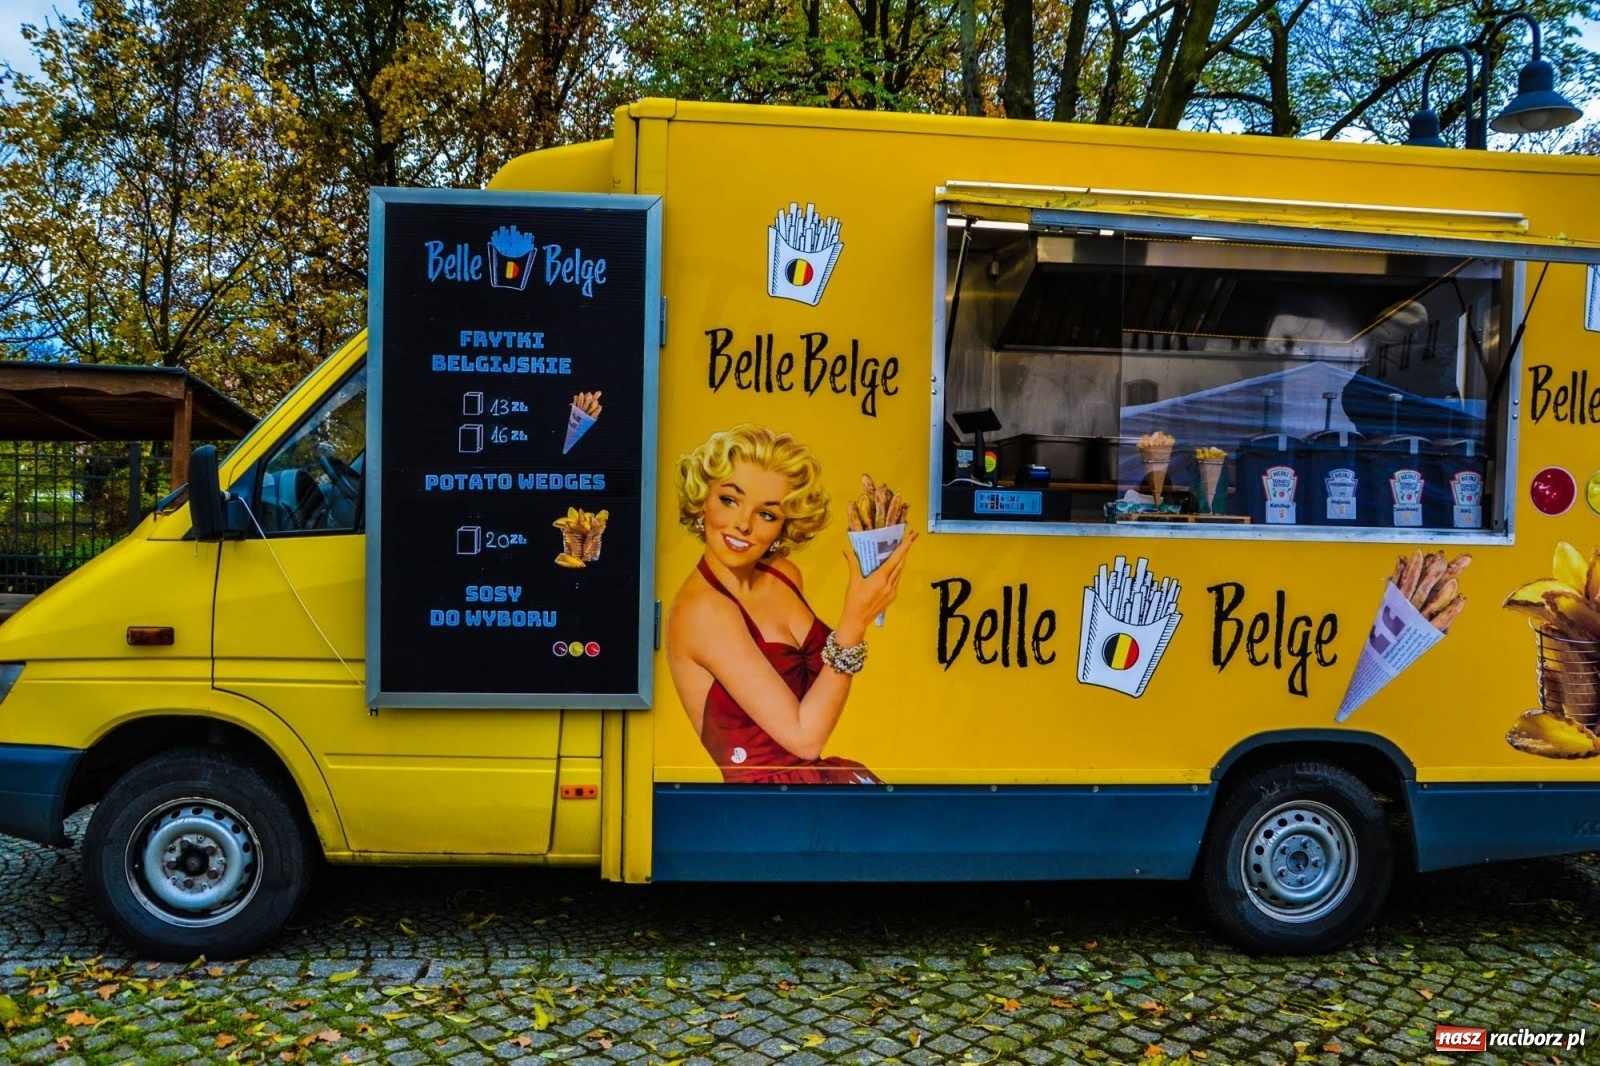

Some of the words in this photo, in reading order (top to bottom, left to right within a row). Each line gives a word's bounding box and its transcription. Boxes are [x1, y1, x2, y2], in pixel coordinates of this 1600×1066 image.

[425, 240, 483, 283] Belle
[542, 244, 607, 298] Belge
[460, 330, 545, 349] FRYTKI
[432, 355, 572, 375] BELGIJSKIE
[704, 328, 795, 394] Belle
[800, 332, 899, 418] Belge
[425, 474, 512, 491] POTATO
[518, 474, 606, 490] WEDGES
[1272, 470, 1290, 478] HEINZ
[466, 586, 522, 602] SOSY
[430, 610, 460, 627] DO
[466, 610, 557, 627] WYBORU
[930, 577, 1057, 672] Belle
[1207, 582, 1339, 698] Belge
